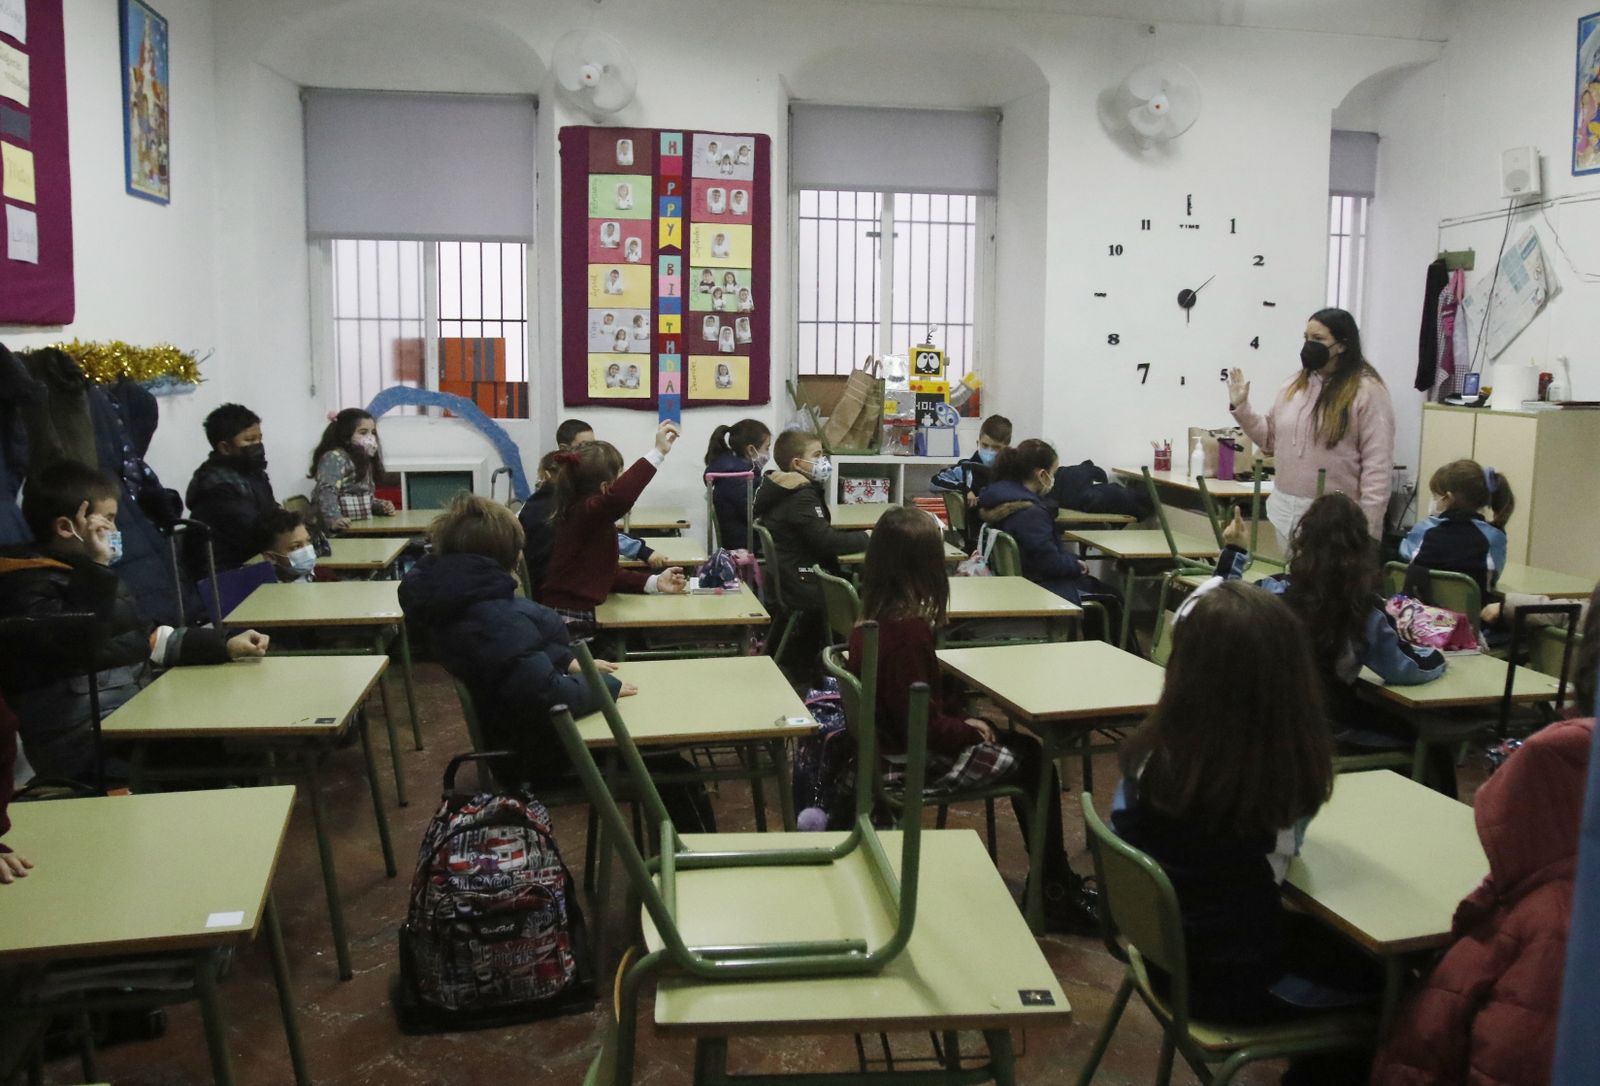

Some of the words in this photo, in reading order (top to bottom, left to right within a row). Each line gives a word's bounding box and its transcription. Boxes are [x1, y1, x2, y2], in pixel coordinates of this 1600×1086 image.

[1141, 219, 1151, 231] 11
[1229, 218, 1237, 234] 1
[1108, 244, 1124, 256] 10
[1252, 255, 1265, 266] 2
[1107, 333, 1120, 346] 8
[1249, 336, 1260, 350] 4
[1136, 363, 1151, 385] 7
[1220, 368, 1229, 381] 5
[915, 401, 935, 411] HOL
